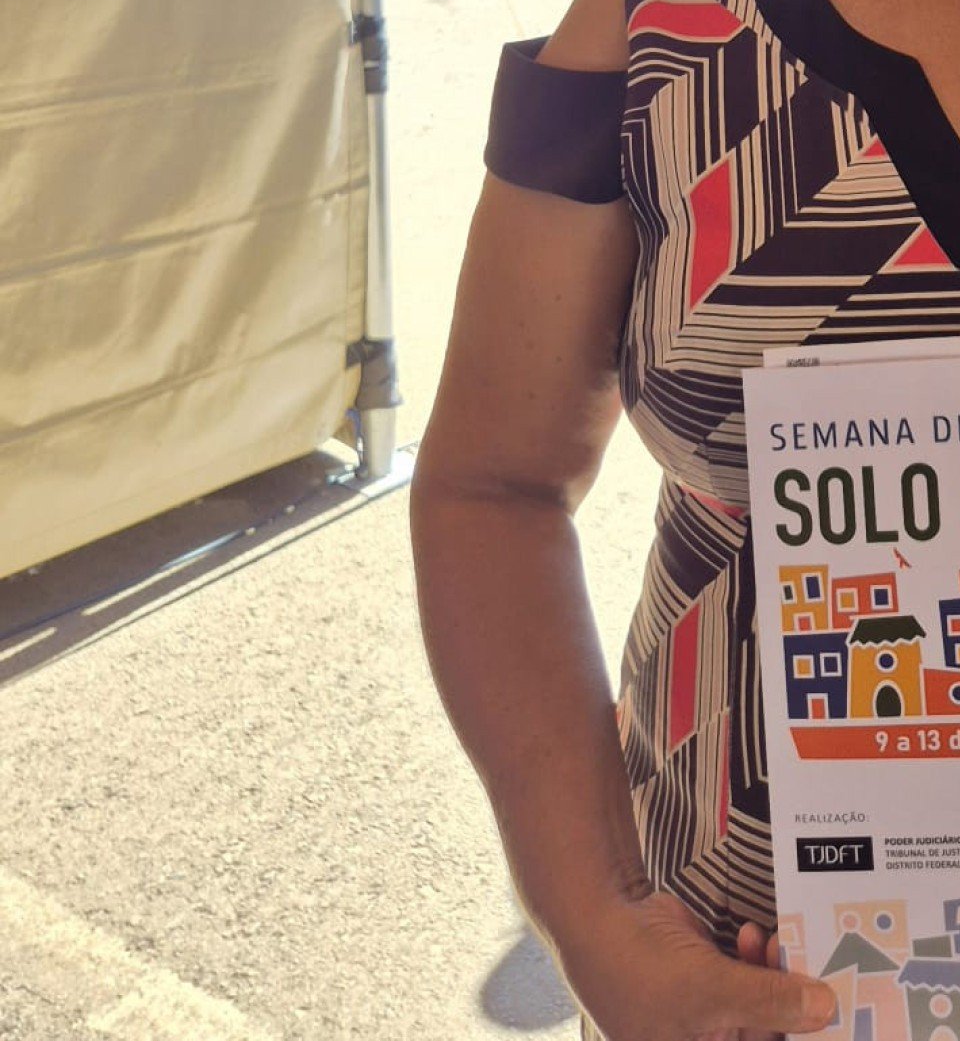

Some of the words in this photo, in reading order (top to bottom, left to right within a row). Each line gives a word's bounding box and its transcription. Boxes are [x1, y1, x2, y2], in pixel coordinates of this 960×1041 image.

[770, 417, 915, 451] SEMANA
[774, 463, 941, 546] SOLO
[875, 731, 888, 752] 9
[897, 735, 910, 751] a
[917, 729, 940, 751] 13
[884, 837, 913, 846] PODER
[803, 844, 864, 865] TJDFT
[885, 849, 926, 858] TRIBUNAL
[928, 849, 940, 857] DE
[885, 861, 924, 870] DISTRITO
[926, 861, 960, 869] FEDERAL
